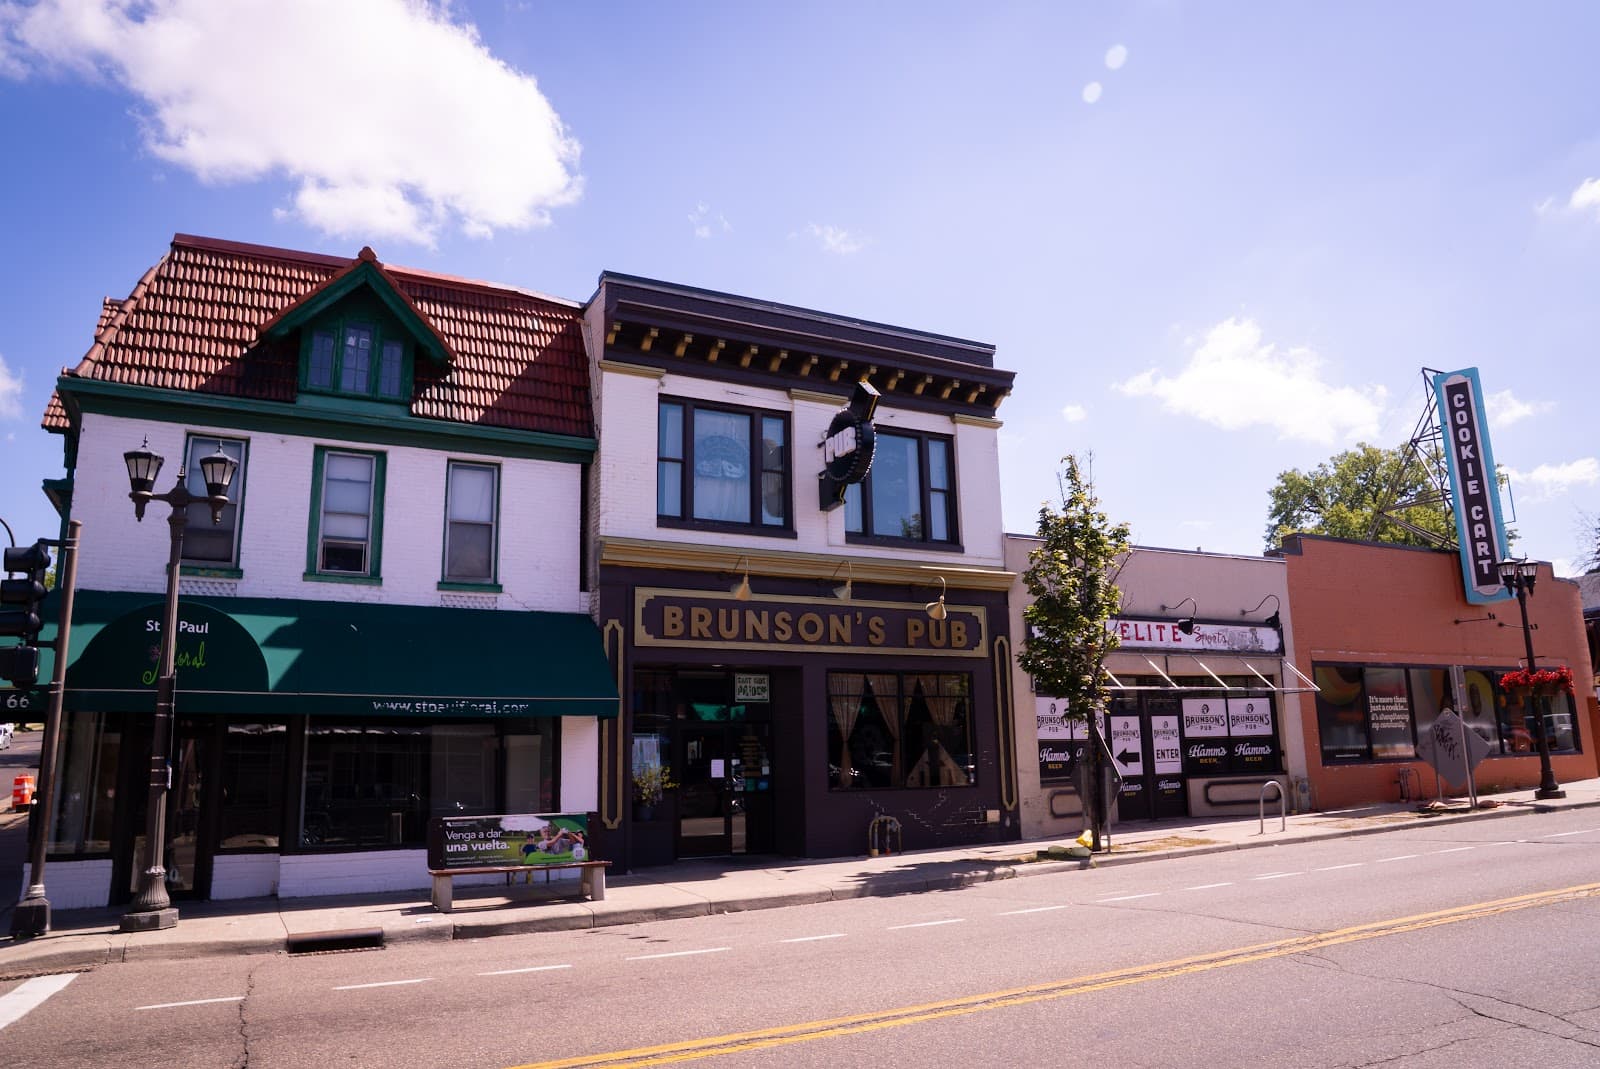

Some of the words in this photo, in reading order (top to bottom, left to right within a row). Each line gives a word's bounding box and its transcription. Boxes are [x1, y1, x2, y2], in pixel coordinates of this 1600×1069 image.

[825, 426, 857, 463] PUB
[1453, 392, 1480, 496] COOKIE
[1470, 505, 1493, 575] CART
[146, 619, 161, 632] St
[179, 620, 209, 634] Paul
[663, 605, 886, 645] BRUNSON'S
[906, 617, 968, 648] PUB
[1119, 623, 1183, 643] ELITE
[1185, 714, 1226, 729] BRUNSON'S
[1230, 713, 1270, 728] BRUNSON'S
[1156, 748, 1180, 760] ENTER
[445, 830, 477, 843] Venga
[446, 844, 469, 852] una
[470, 840, 511, 851] vuelta.
